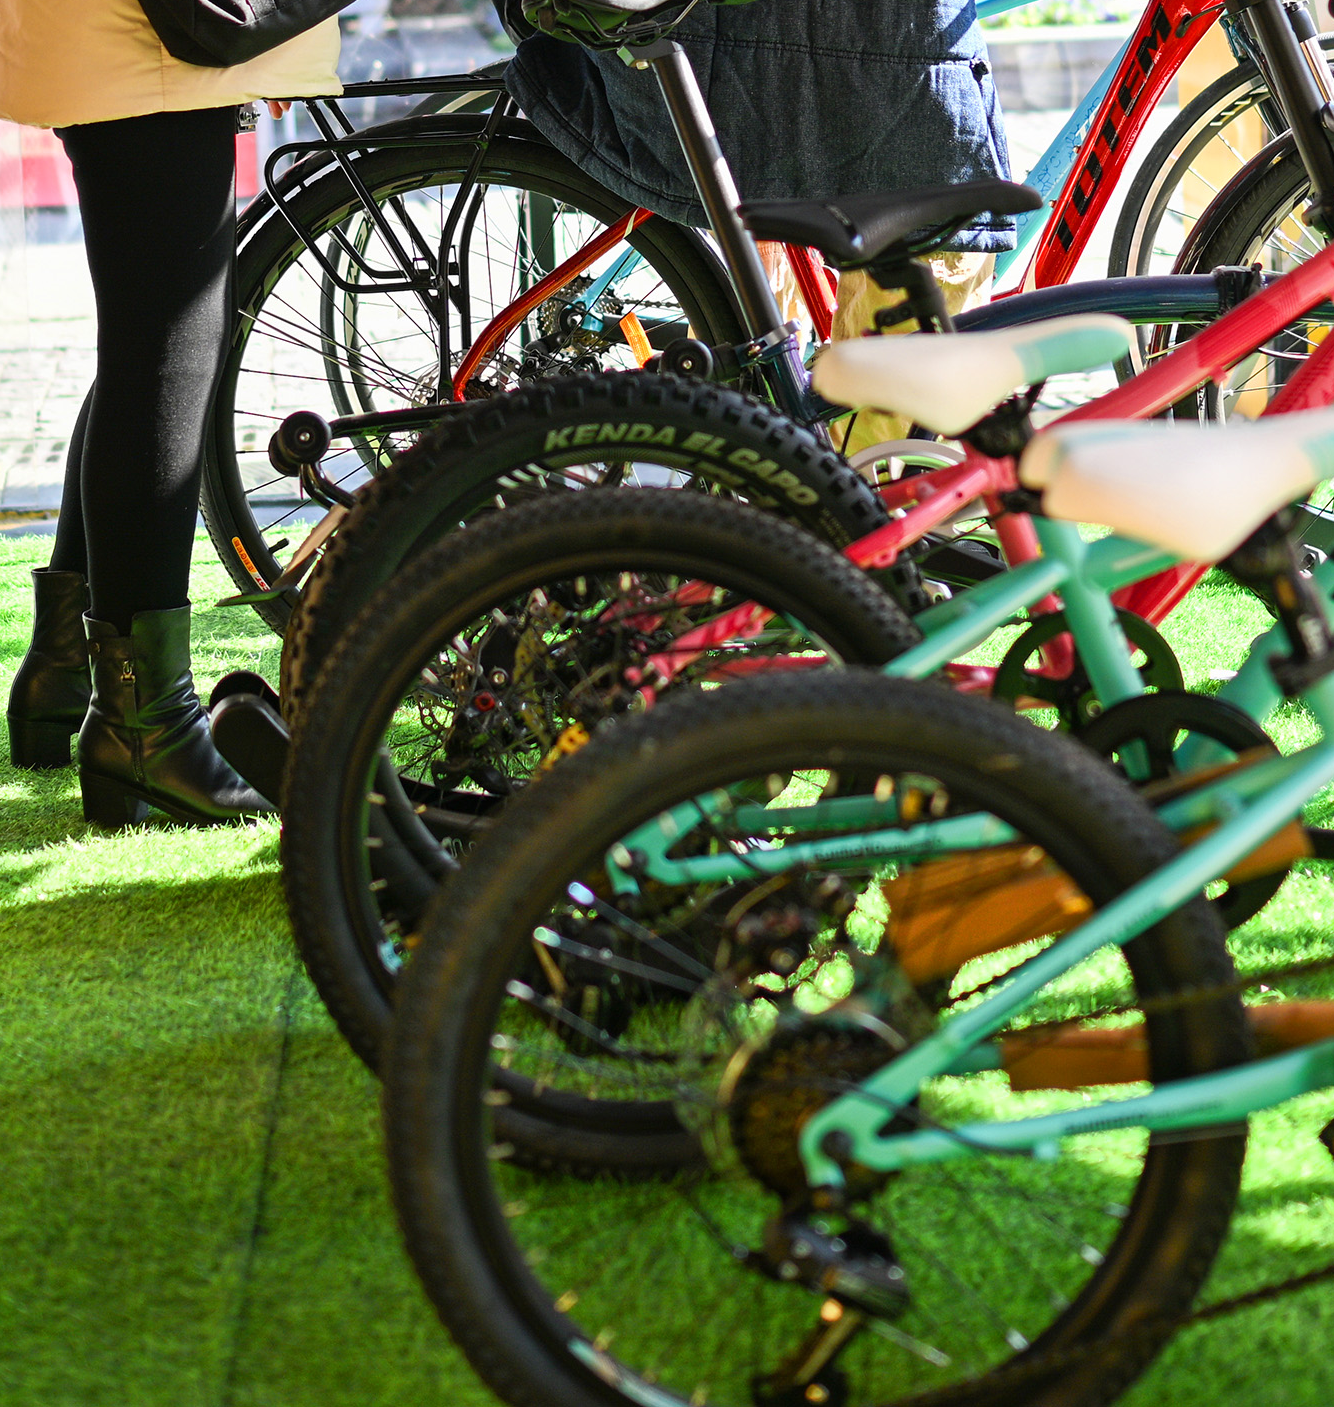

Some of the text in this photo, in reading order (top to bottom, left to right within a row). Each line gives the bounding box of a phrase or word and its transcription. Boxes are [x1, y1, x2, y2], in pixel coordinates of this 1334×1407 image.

[1048, 3, 1172, 252] TOTEM
[543, 422, 678, 452] KENDA
[681, 431, 728, 456] EL
[727, 447, 820, 507] CAPO
